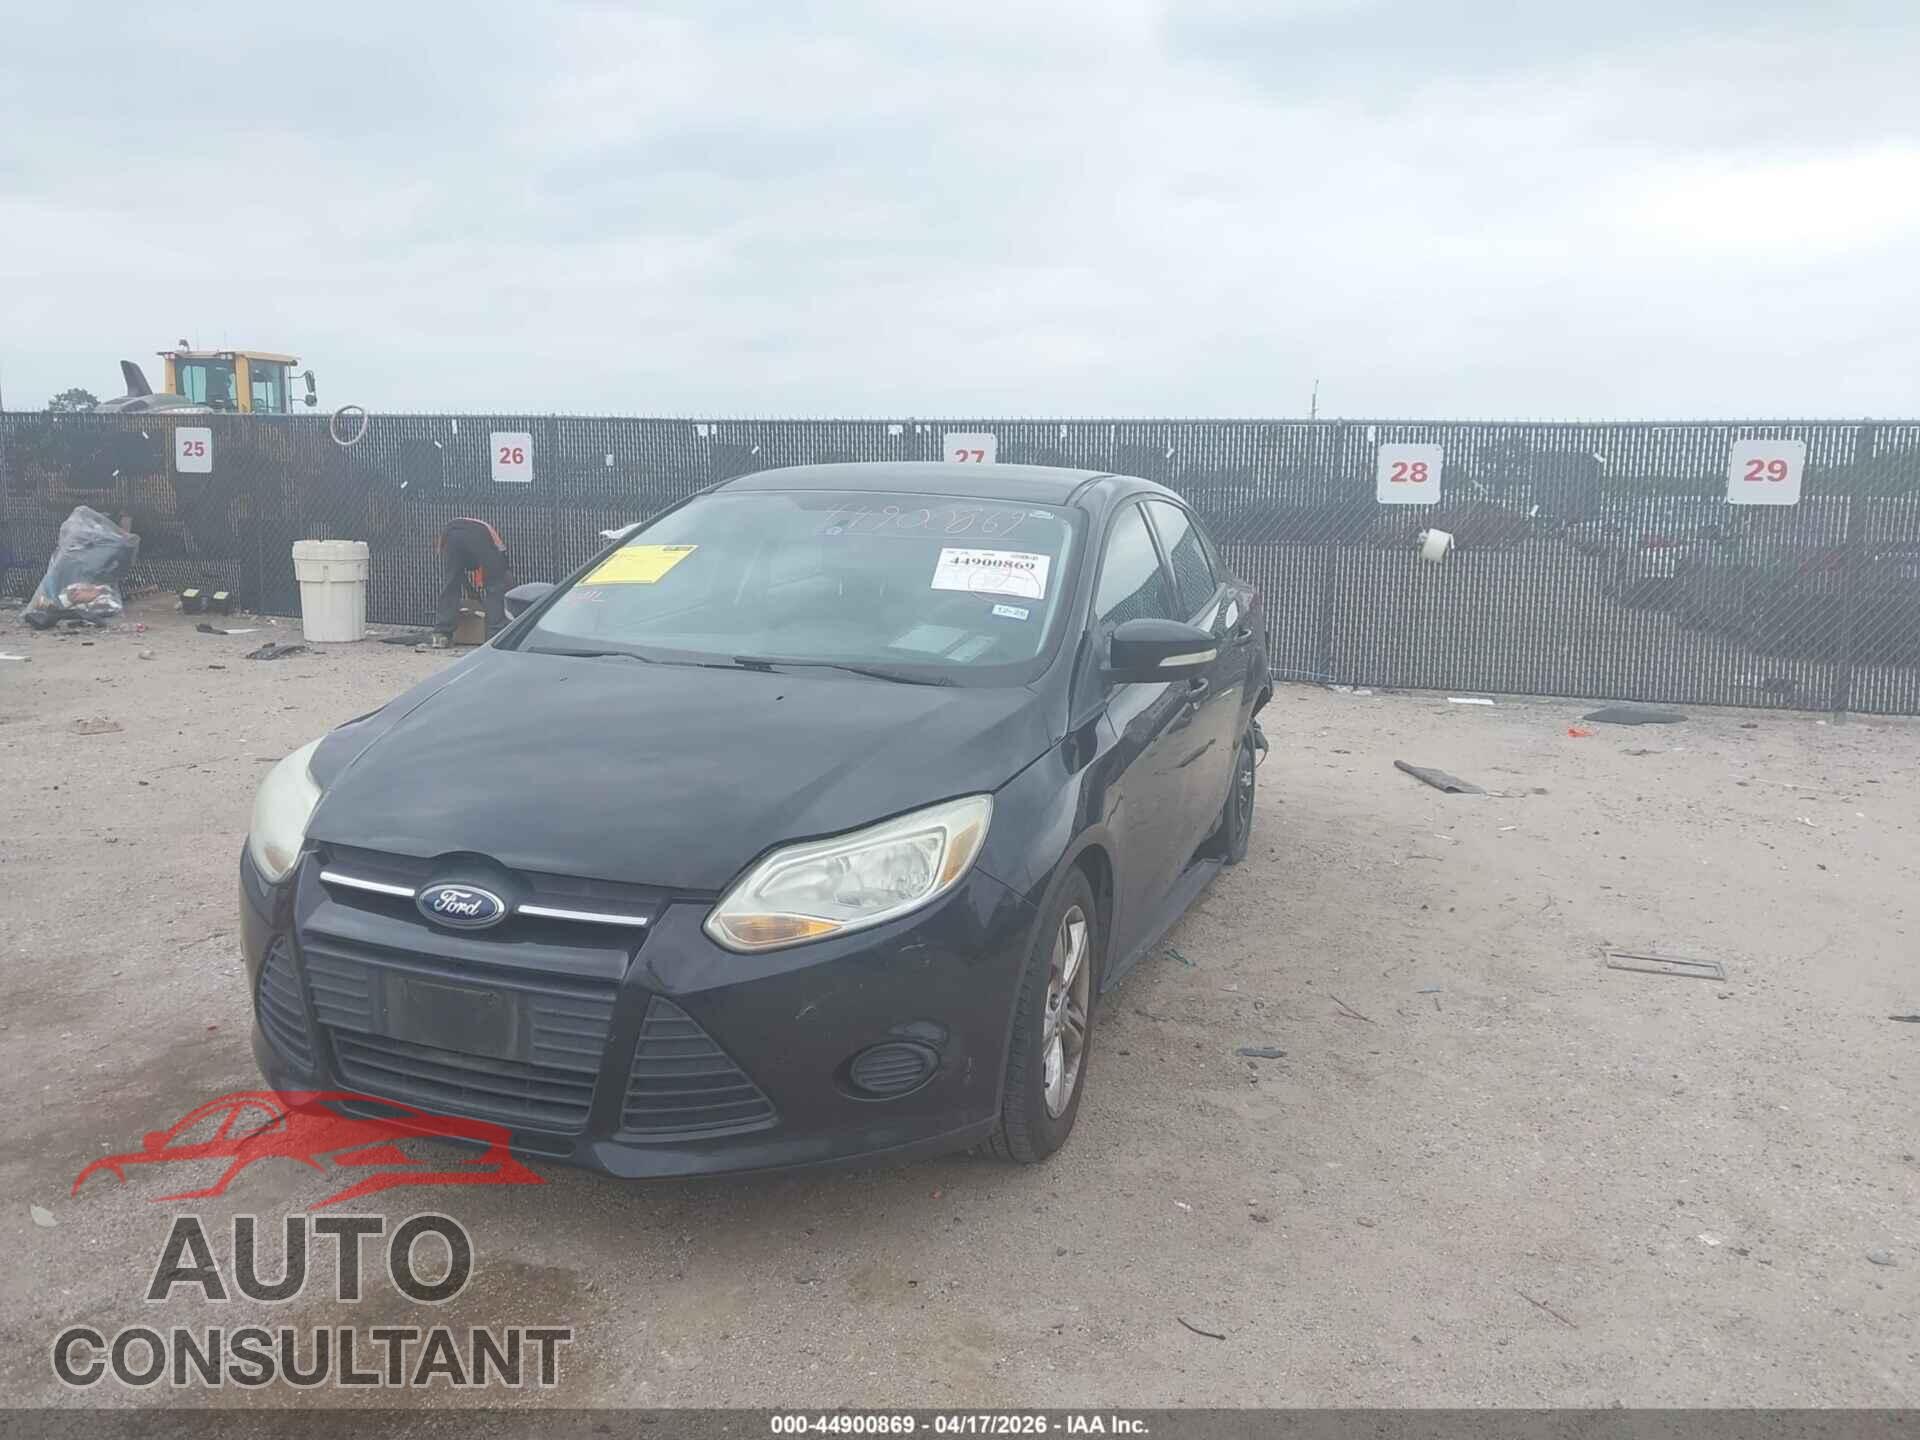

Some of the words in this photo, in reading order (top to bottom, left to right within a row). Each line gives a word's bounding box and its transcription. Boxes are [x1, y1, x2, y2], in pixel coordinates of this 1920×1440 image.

[183, 440, 205, 457] 25
[499, 447, 524, 464] 26
[1390, 461, 1428, 483] 28
[1743, 459, 1788, 482] 29
[949, 556, 1036, 571] 44900869
[433, 888, 483, 916] Ford
